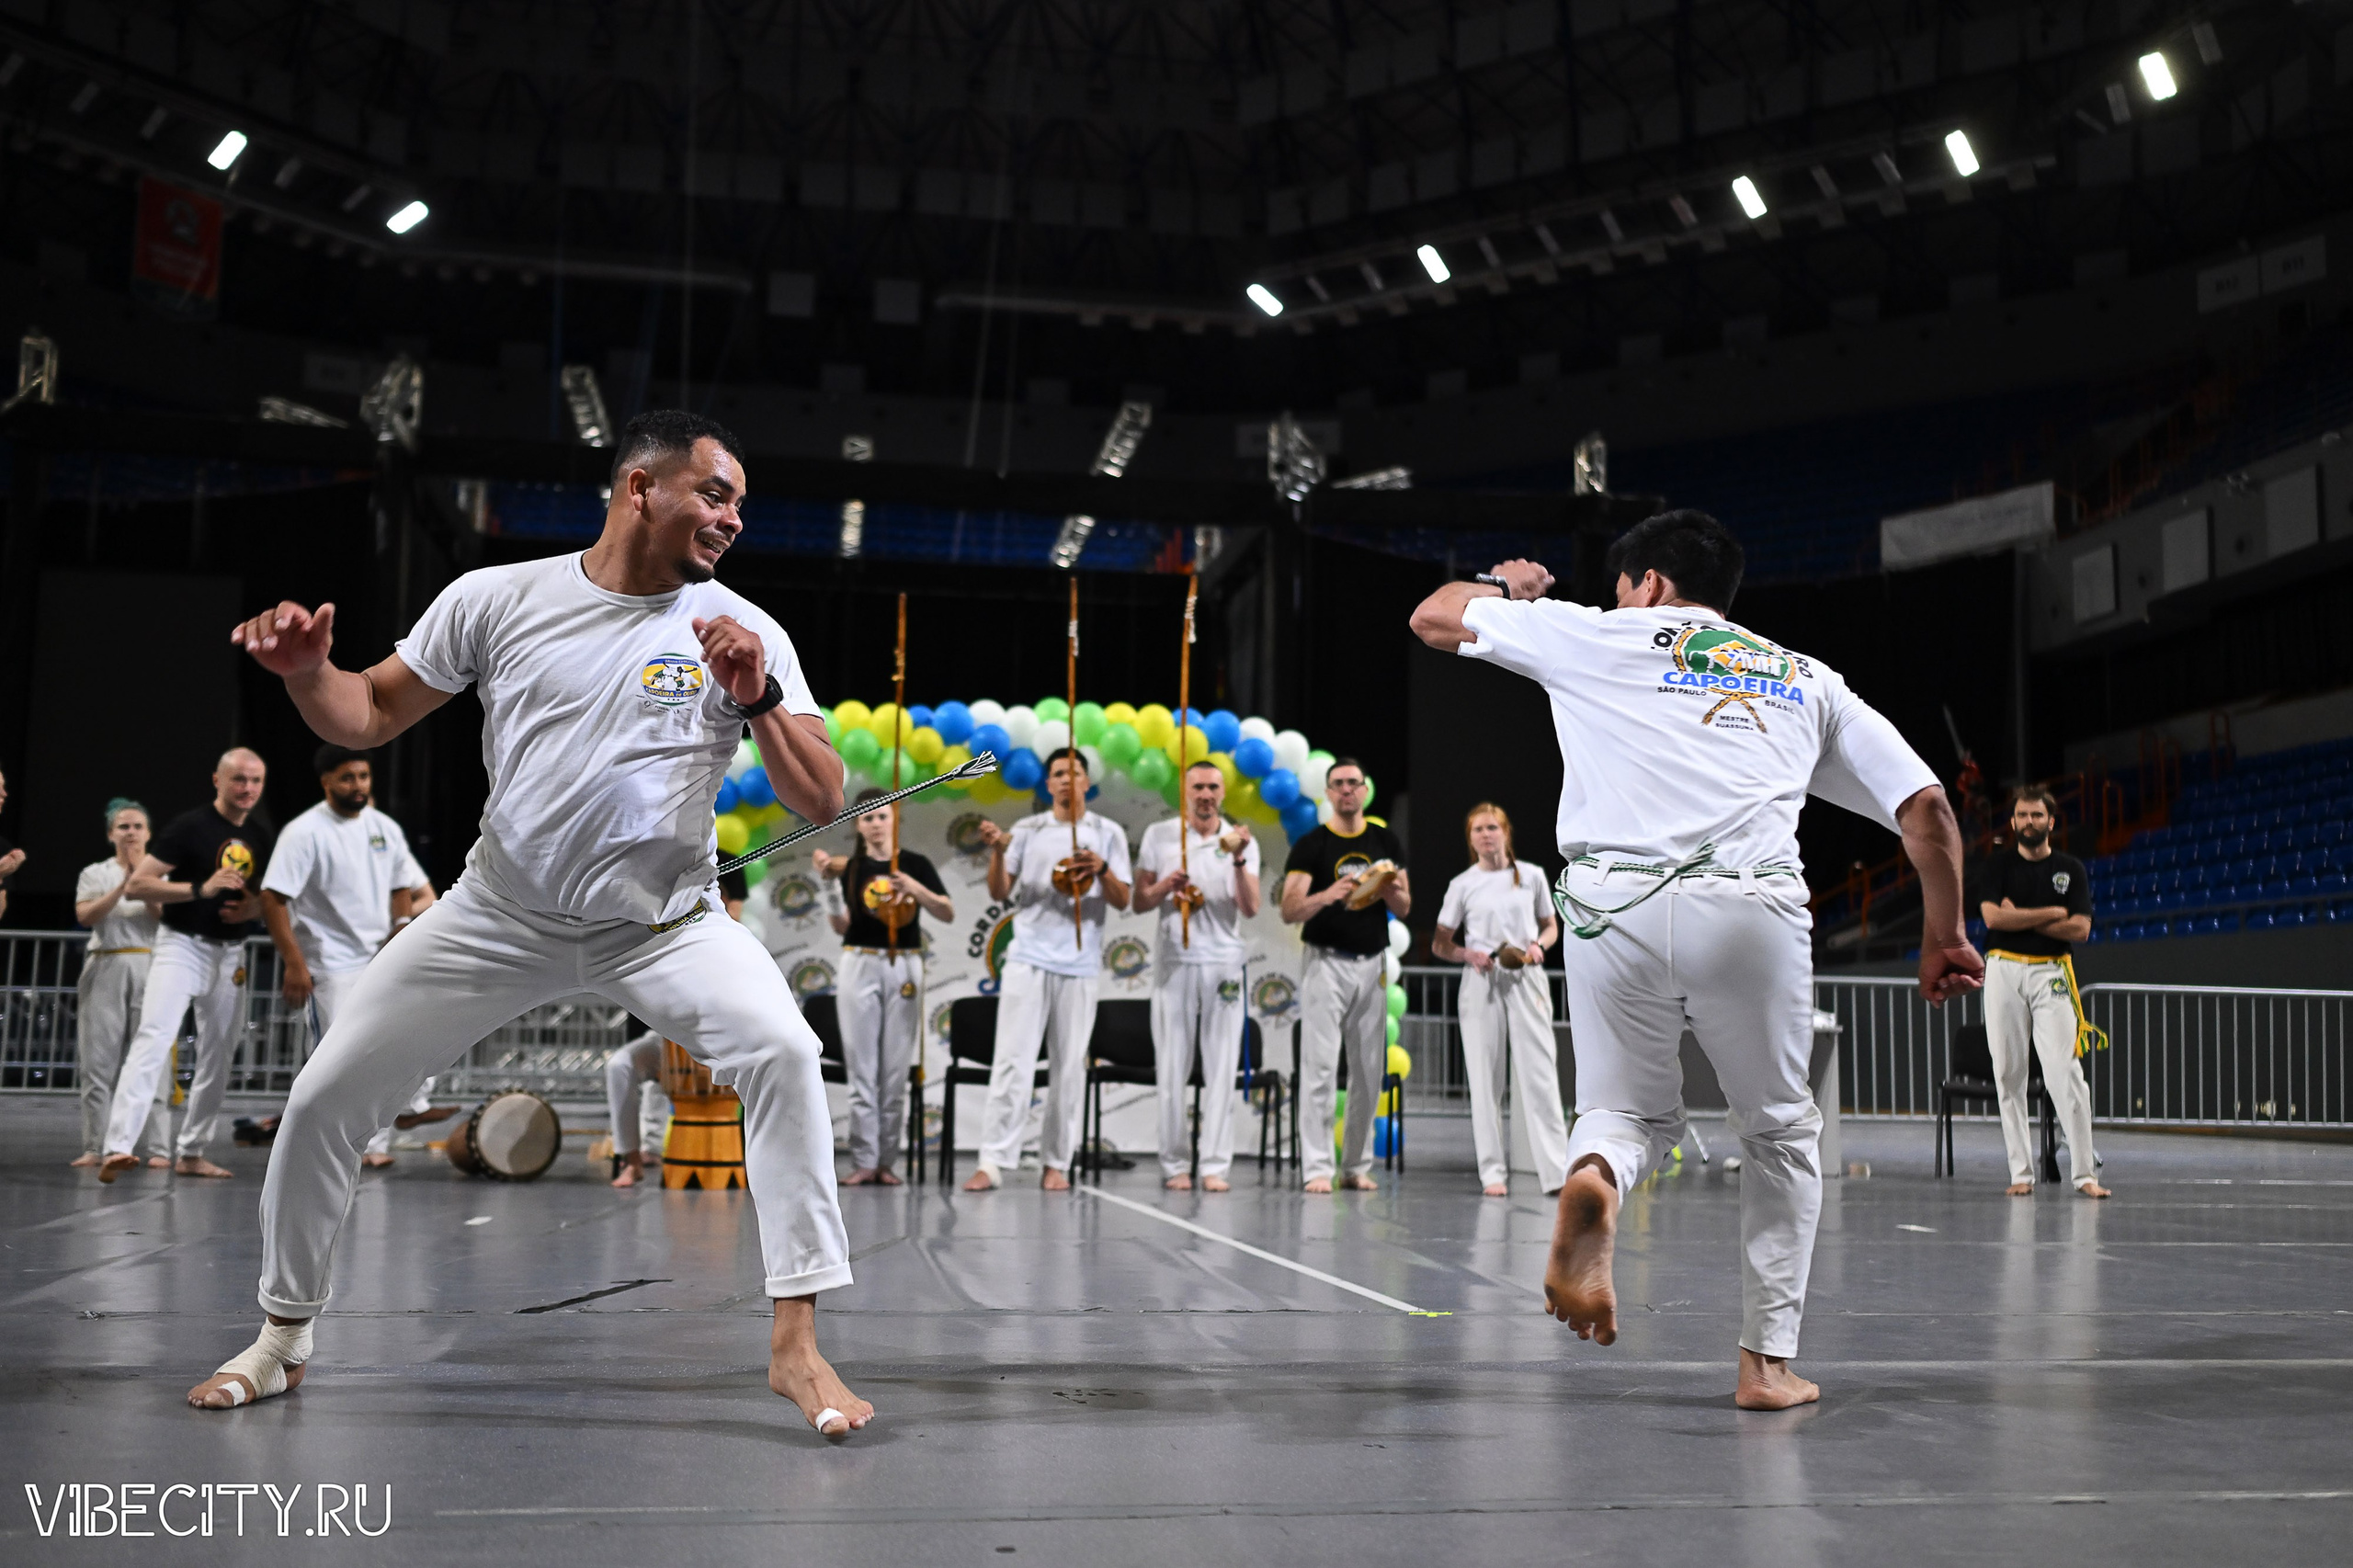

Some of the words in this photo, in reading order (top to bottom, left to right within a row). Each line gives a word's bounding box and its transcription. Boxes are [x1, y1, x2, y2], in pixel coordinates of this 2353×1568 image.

[1663, 672, 1804, 706] CAPOEIRA
[1678, 687, 1707, 696] PAULO
[1765, 699, 1795, 715] BRASIL
[1720, 715, 1749, 723] MESTRE
